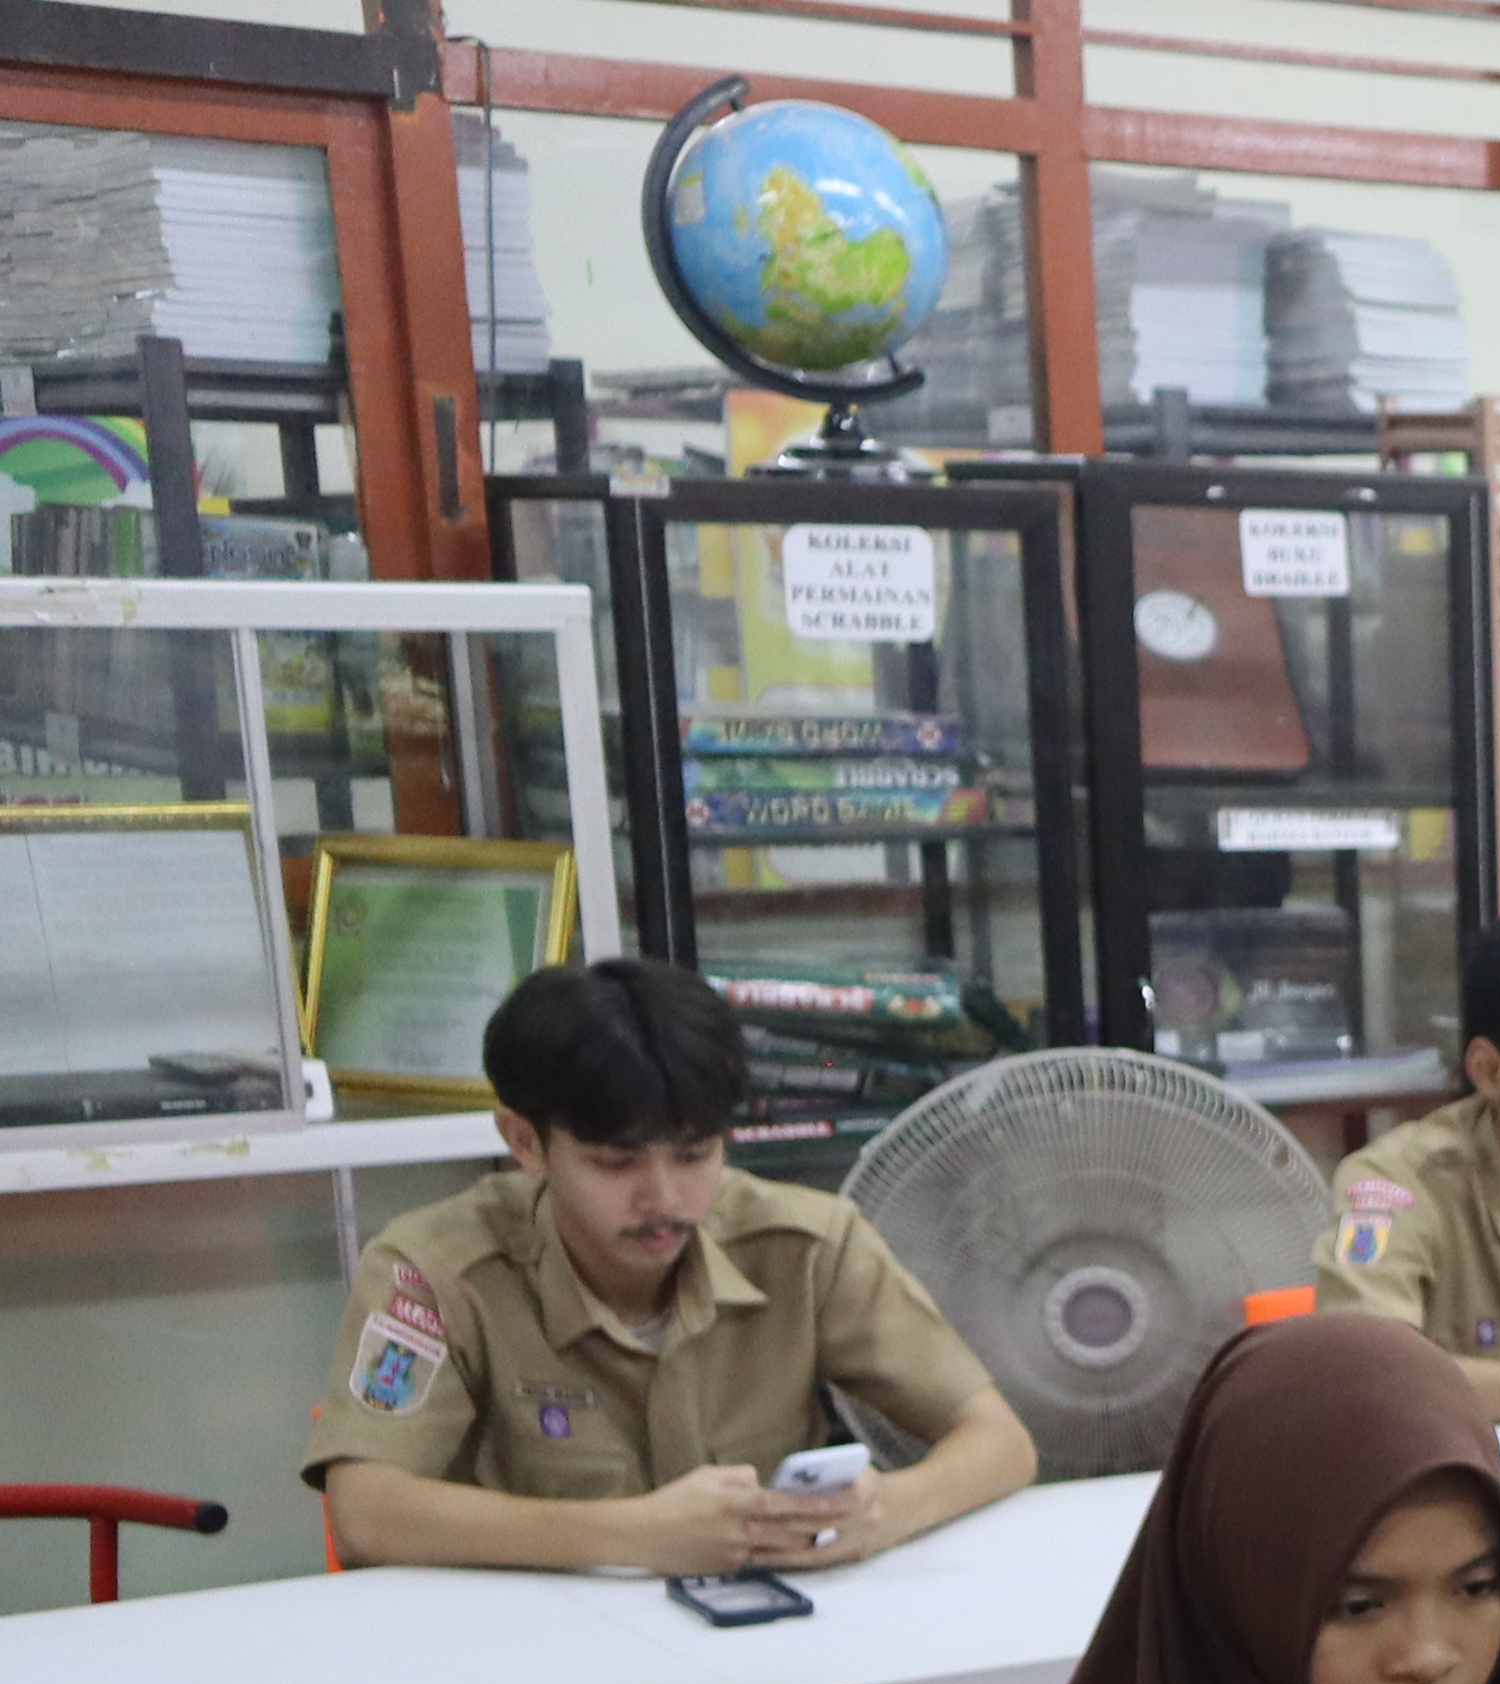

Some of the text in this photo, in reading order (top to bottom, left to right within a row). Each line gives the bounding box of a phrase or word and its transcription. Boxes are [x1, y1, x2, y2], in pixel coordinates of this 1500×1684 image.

[1248, 521, 1337, 537] KOLEKSI
[808, 532, 911, 552] KOLEKSI
[831, 559, 889, 578] ALAT
[792, 584, 931, 604] PERMAINAN
[801, 611, 920, 630] SCRABBLE
